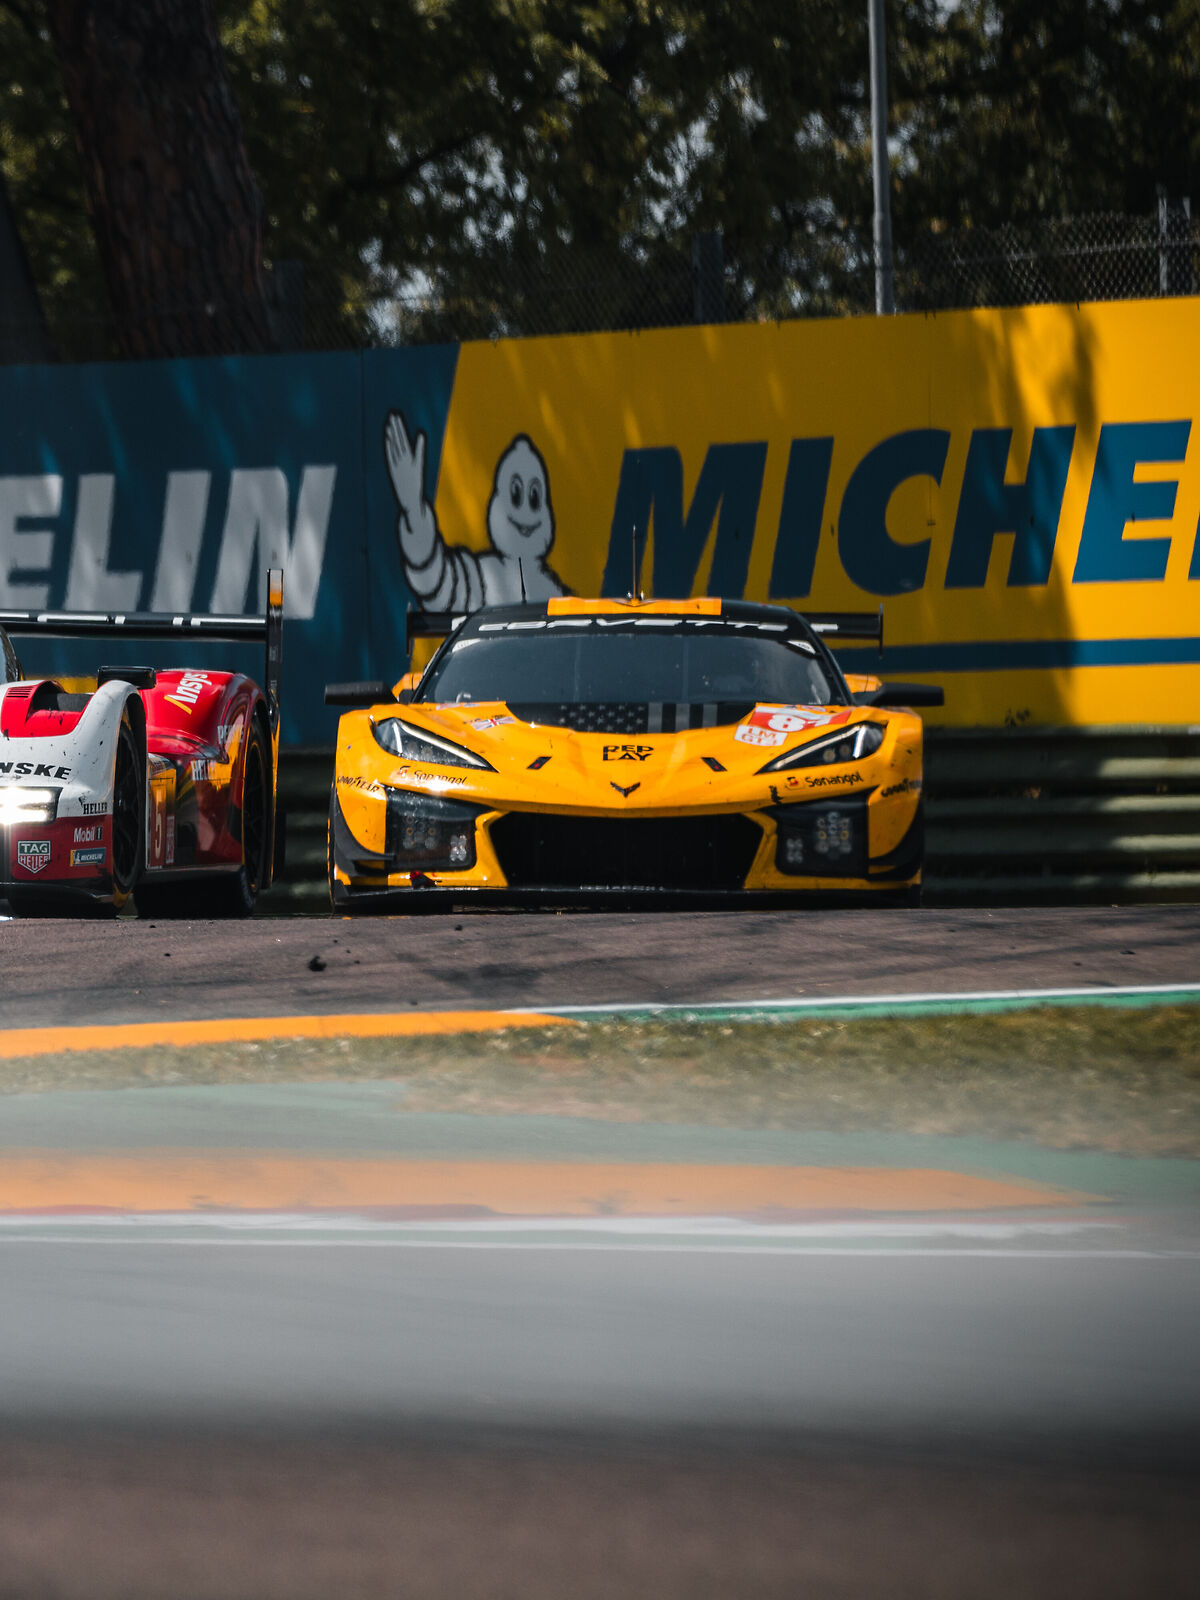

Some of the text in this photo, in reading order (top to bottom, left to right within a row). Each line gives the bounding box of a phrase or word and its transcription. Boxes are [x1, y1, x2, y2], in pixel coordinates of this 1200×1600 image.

[601, 419, 1200, 600] MICHE
[20, 843, 48, 853] TAG
[20, 855, 49, 871] HEUER
